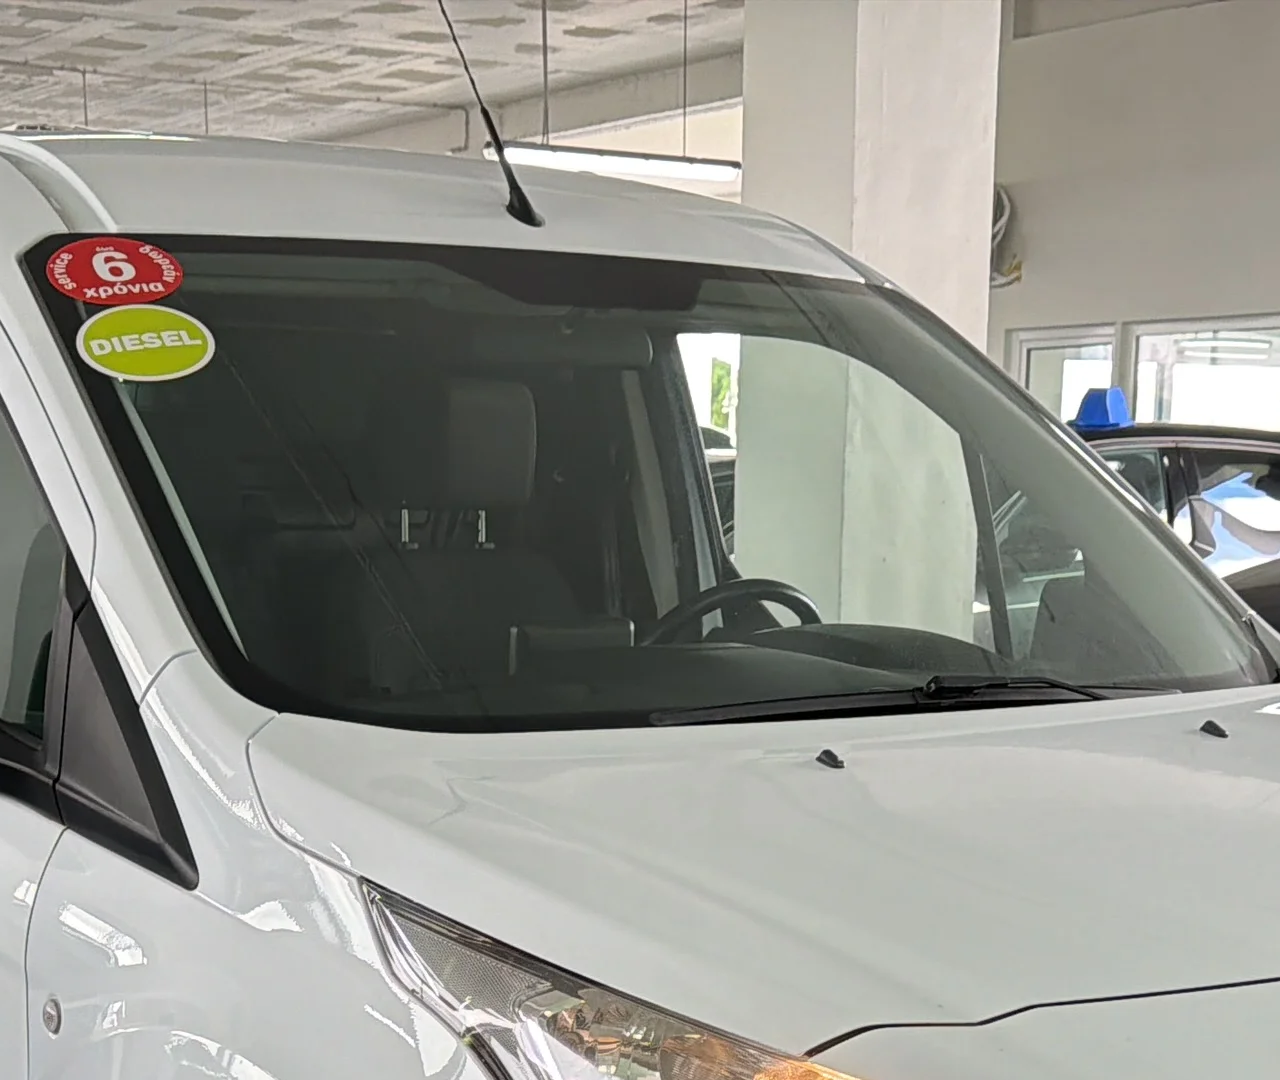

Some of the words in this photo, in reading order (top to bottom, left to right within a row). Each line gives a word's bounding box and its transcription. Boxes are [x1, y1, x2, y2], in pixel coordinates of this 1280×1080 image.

[53, 252, 77, 290] service
[92, 251, 136, 282] 6
[138, 244, 181, 284] δωρεάν
[82, 281, 166, 299] χρόνια
[88, 329, 203, 357] DIESEL
